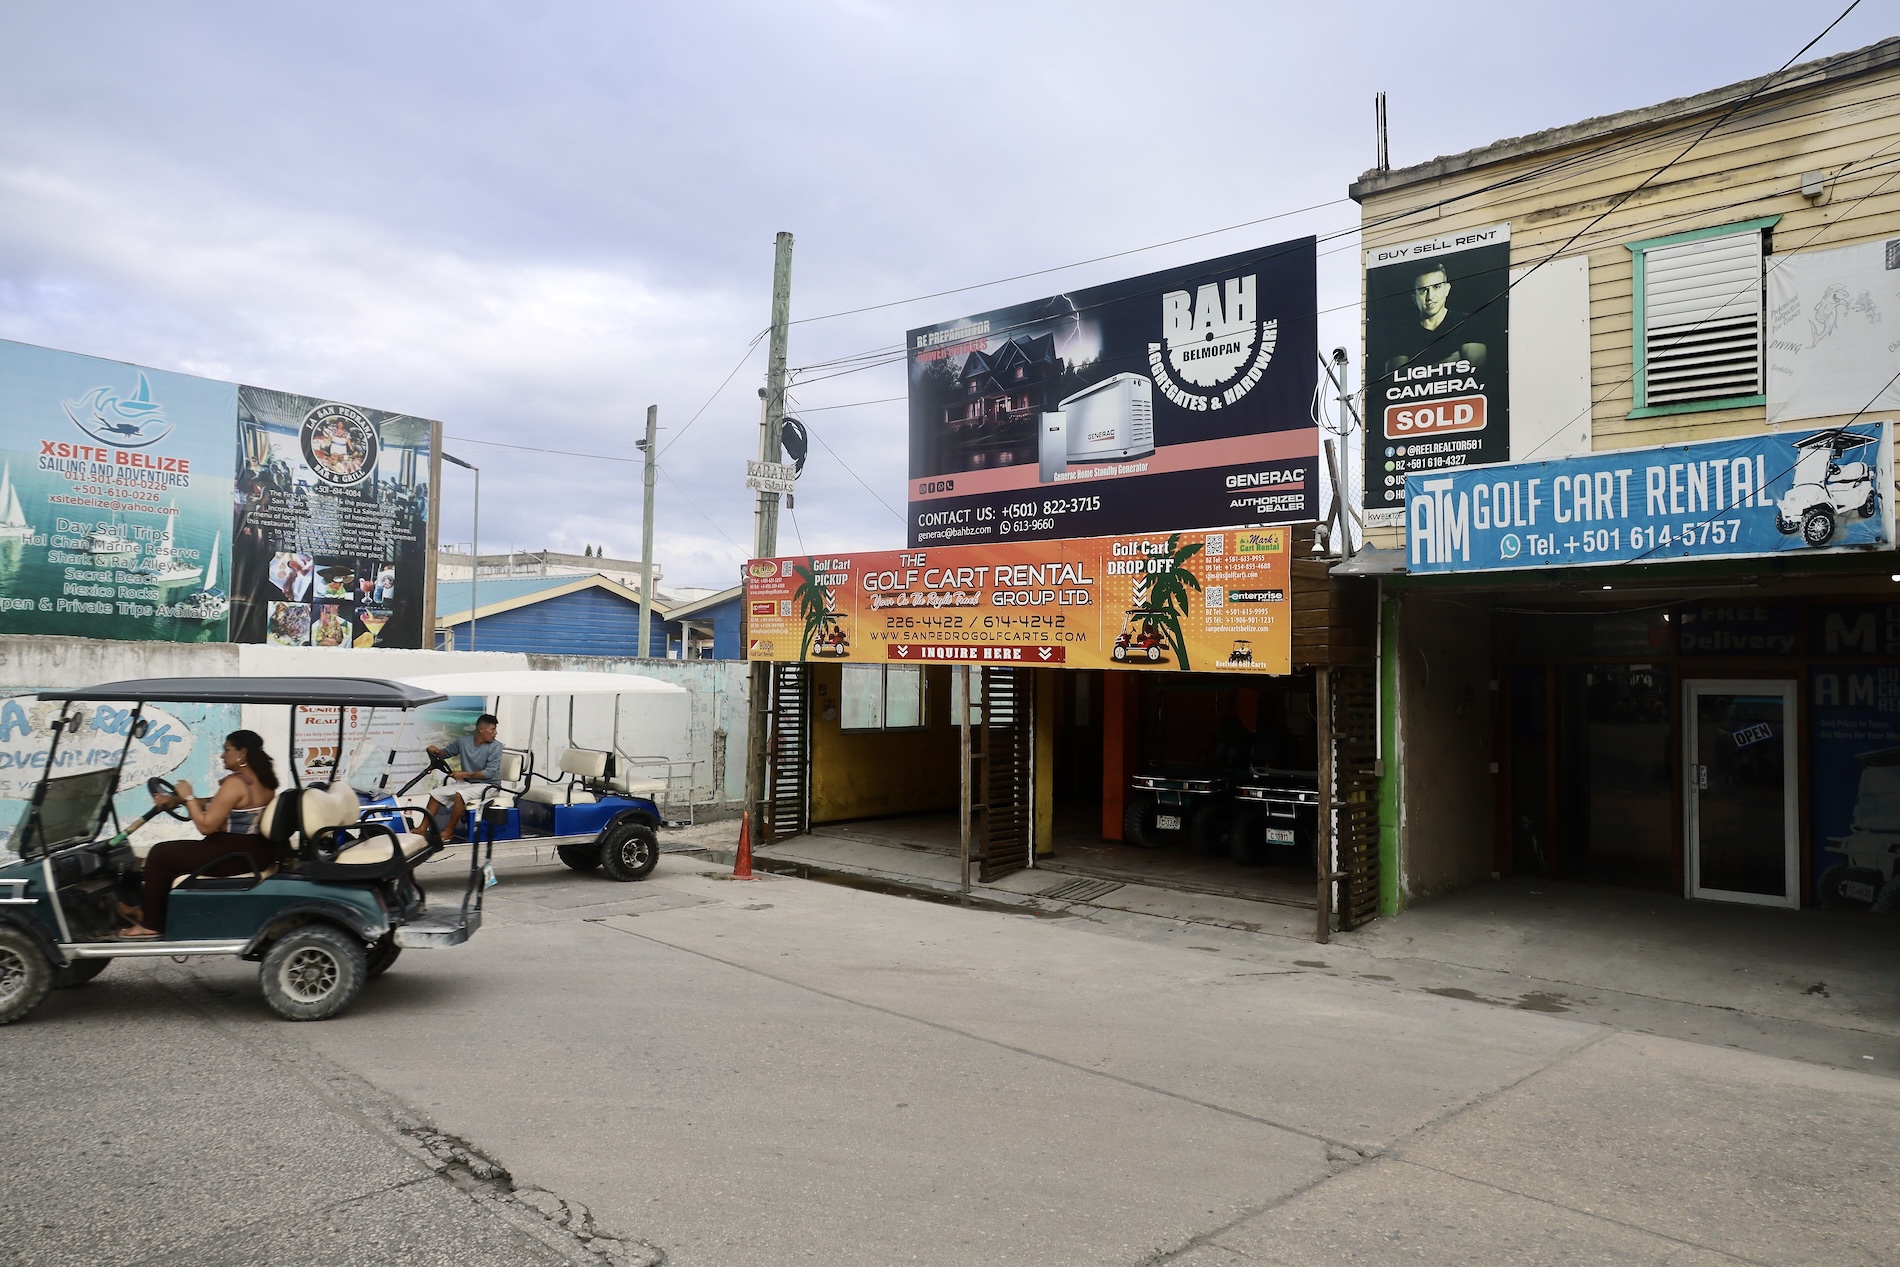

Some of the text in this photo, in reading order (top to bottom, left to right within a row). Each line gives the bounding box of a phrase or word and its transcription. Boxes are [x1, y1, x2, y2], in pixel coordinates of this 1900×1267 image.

[1378, 230, 1497, 261] BUY SELL RENT
[1162, 274, 1256, 337] BAH
[917, 334, 928, 348] BE
[972, 320, 990, 336] FOR
[1183, 342, 1240, 362] BELMOPAN
[1769, 340, 1802, 354] DIVING
[1148, 319, 1278, 412] AGGREGATES & HARDWARE
[1394, 360, 1476, 383] LIGHTS,
[1386, 380, 1486, 400] CAMERA,
[306, 406, 374, 439] LA SAN PEDRANA
[1396, 404, 1474, 431] SOLD
[1088, 430, 1114, 440] GENERAC
[1407, 439, 1482, 456] @REELREALTOR501
[40, 440, 190, 474] XSITE BELIZE
[1396, 460, 1405, 470] BZ
[1407, 459, 1426, 470] +501
[39, 456, 189, 488] SAILING AND ADVENTURES
[64, 470, 167, 491] 011-501-610-0226
[314, 464, 330, 480] BAR
[342, 469, 366, 482] GRILL
[1054, 462, 1148, 482] Generac Home Standby Generator
[1226, 468, 1304, 488] GENERAC
[1396, 475, 1405, 485] US
[72, 485, 160, 502] +501-610-0226
[1230, 494, 1304, 508] AUTHORIZED
[1396, 490, 1406, 500] HO
[49, 494, 180, 515] xsitebelize@yahoo.com
[268, 504, 310, 516] Incorporating
[356, 501, 378, 510] pioneer
[918, 496, 1100, 527] CONTACT US: +(501) 822-3715
[1257, 502, 1304, 514] DEALER
[1411, 454, 1773, 564] ATM GOLF CART RENTAL
[57, 518, 170, 542] Day Sail Trips
[260, 520, 295, 528] restaurant
[1013, 518, 1054, 532] 613-9660
[918, 526, 992, 542] generac@bahbz.com
[1250, 534, 1279, 545] Mark's
[1526, 520, 1740, 557] Tel. +501 614-5757
[22, 533, 199, 560] Hol Chan Marine Reserve
[1112, 540, 1170, 557] Golf Cart
[1256, 543, 1280, 552] Rental
[48, 550, 176, 574] Shark & Ray Alley
[814, 558, 850, 572] Golf Cart
[900, 553, 926, 568] THE
[1224, 554, 1266, 562] +501-633-9955
[1108, 558, 1174, 576] DROP OFF
[65, 568, 158, 585] Secret Beach
[814, 574, 848, 586] PICKUP
[863, 562, 1094, 591] GOLF CART RENTAL
[64, 583, 159, 600] Mexico Rocks
[896, 592, 909, 606] On
[910, 592, 926, 607] The
[927, 591, 952, 609] Right
[953, 590, 982, 607] Track
[992, 589, 1092, 606] GROUP LTD.
[1231, 591, 1282, 602] enterprise
[0, 597, 220, 620] pen & Private Trips Available
[1226, 608, 1268, 616] +501-615-9995
[1702, 606, 1768, 622] FREE
[886, 616, 1066, 628] 226-4422 / 614-4242
[1206, 625, 1268, 633] sanpedrocartsbelize.com
[869, 632, 1087, 642] WWW.SANPEDROGOLFCARTS.COM
[1680, 630, 1796, 653] Delivery
[922, 646, 1022, 660] INQUIRE HERE
[1736, 724, 1770, 744] OPEN
